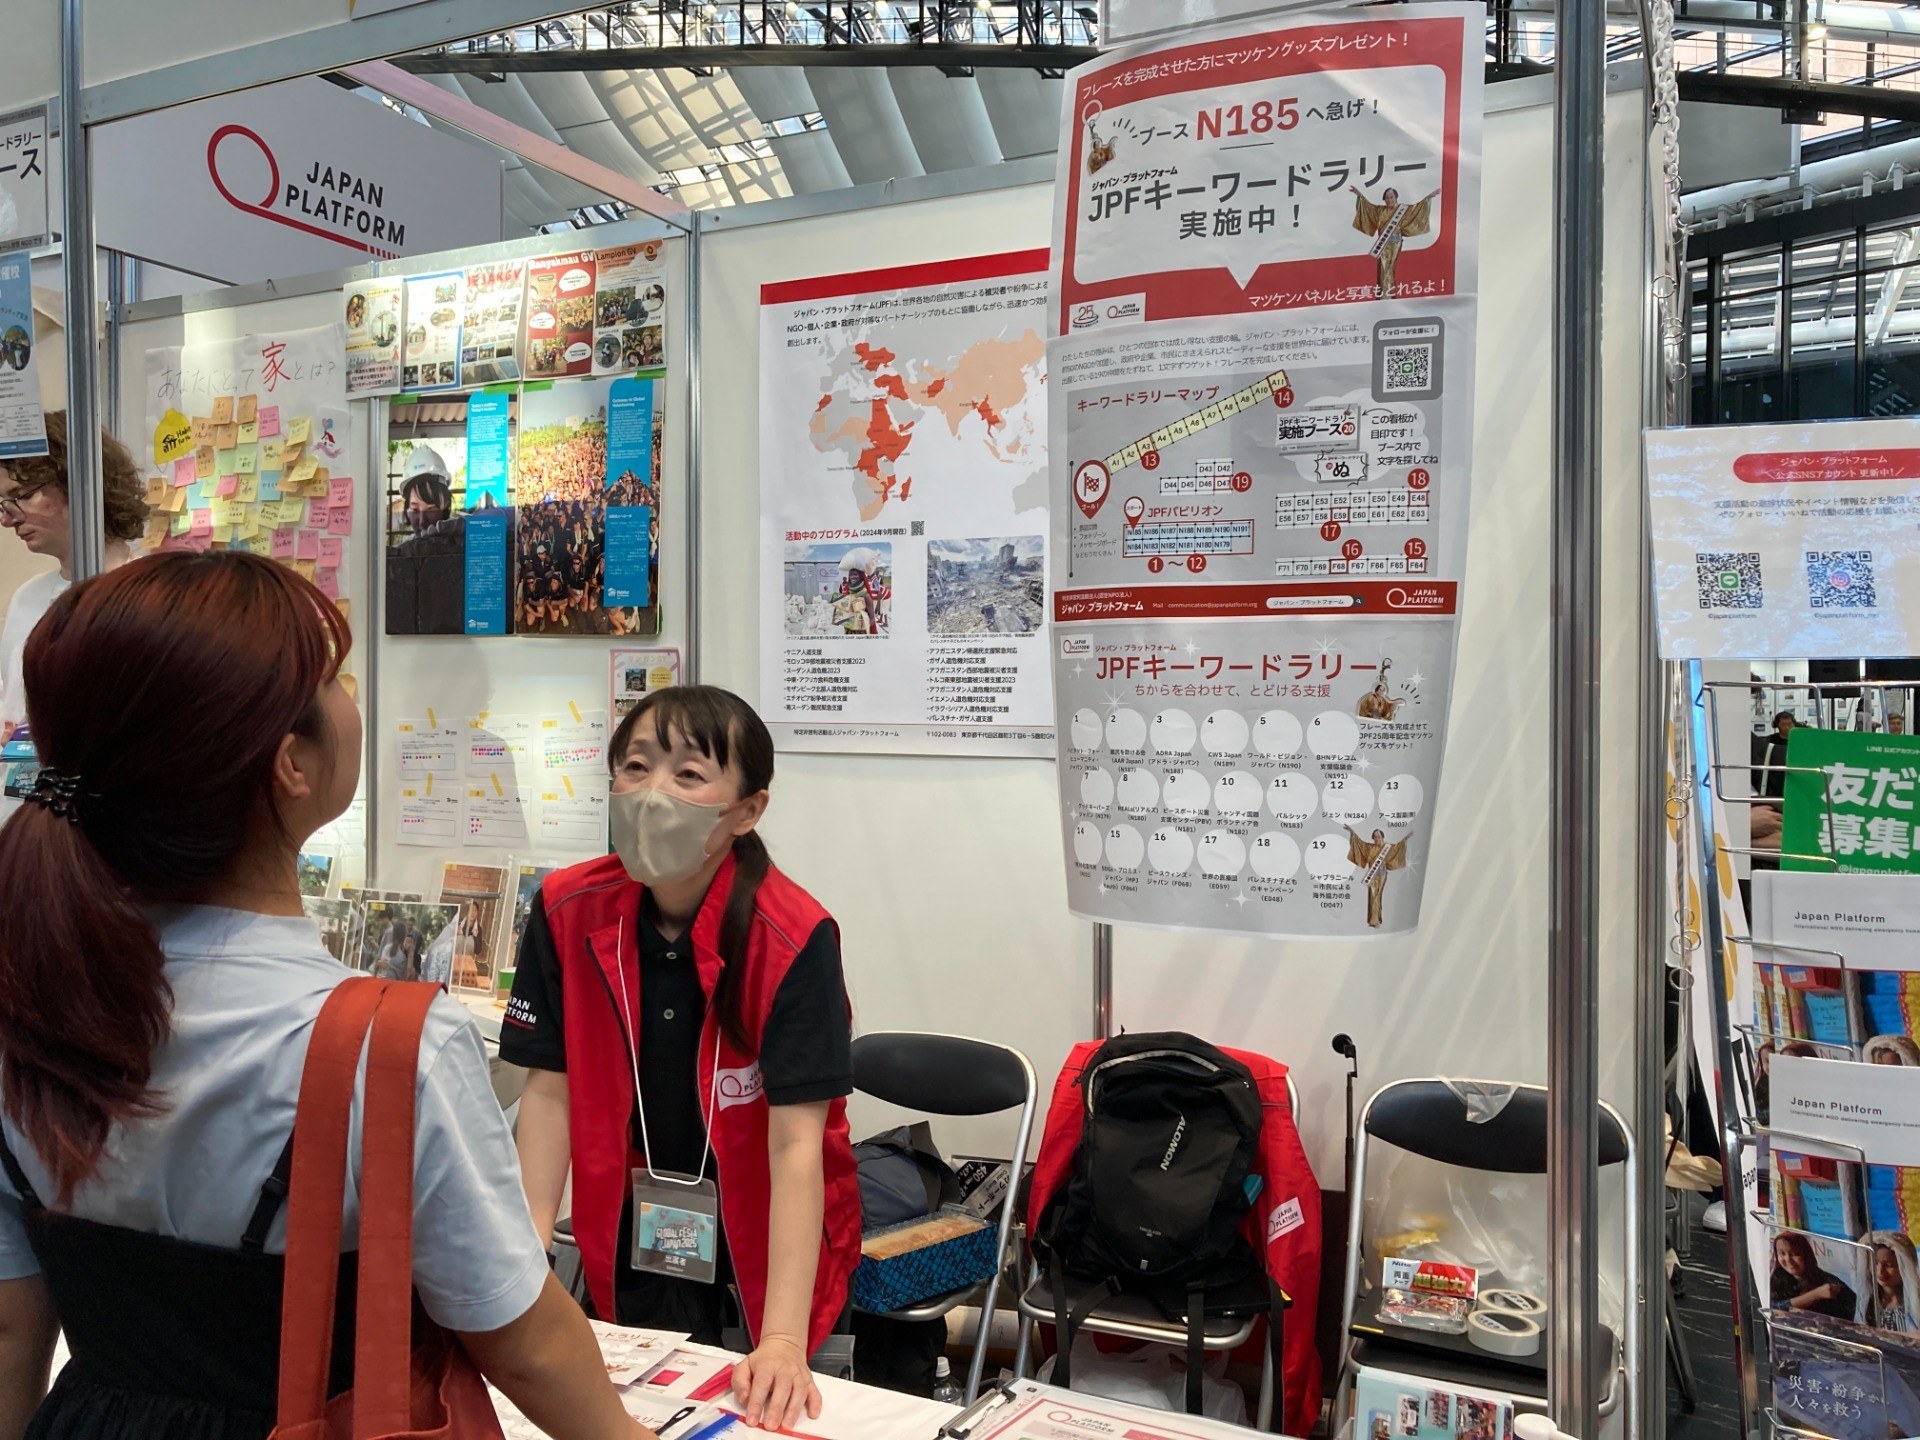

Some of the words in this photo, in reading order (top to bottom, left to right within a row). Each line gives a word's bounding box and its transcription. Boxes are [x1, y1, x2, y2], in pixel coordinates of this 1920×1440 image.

[1139, 121, 1189, 146] ブース
[1197, 97, 1300, 141] N185
[1306, 98, 1380, 121] へ急げ！
[1092, 165, 1178, 190] ジャパン・プラットフォーム
[306, 162, 384, 208] JAPAN
[1088, 154, 1428, 222] JPFキーワードラリー
[285, 184, 405, 246] PLATFORM
[1179, 203, 1301, 240] 実施中！
[581, 252, 594, 262] GV
[596, 249, 625, 260] Lampion
[627, 247, 637, 256] GV
[1248, 279, 1446, 308] マツケンパネルと写真もとれるよ！
[1077, 386, 1220, 412] キーワードラリーマップ
[1277, 391, 1291, 404] 14
[1280, 415, 1355, 426] JPFキーワードラリー
[1371, 412, 1417, 424] この看板が
[1279, 424, 1342, 440] 実施ブース
[1370, 429, 1414, 439] 目印です！
[1378, 442, 1421, 451] ブース内で
[1144, 454, 1157, 466] 13
[1377, 455, 1438, 466] 文字を探してね
[1780, 455, 1888, 467] ジャパン・プラットフォーム
[1199, 465, 1212, 473] D43
[1217, 464, 1231, 472] D42
[1333, 461, 1350, 477] ぬ
[1217, 479, 1230, 487] D47
[1235, 475, 1249, 488] 19
[1412, 473, 1425, 485] 18
[1392, 494, 1405, 502] E49
[1412, 494, 1425, 502] E48
[1147, 506, 1223, 518] JPFパビリオン
[1352, 511, 1366, 519] E60
[785, 529, 859, 541] 活動中のプログラム
[1324, 525, 1337, 537] 17
[1345, 544, 1358, 555] 16
[1407, 542, 1422, 555] 15
[1153, 559, 1158, 570] 1
[1190, 557, 1203, 569] 12
[1278, 564, 1290, 572] F71
[1407, 596, 1444, 604] PLATFORM
[1061, 601, 1144, 613] ジャパン・プラットフォーム
[1095, 644, 1176, 652] ジャパン・プラットフォーム
[1096, 653, 1377, 681] JPFキーワードラリー
[1135, 684, 1331, 698] ちからを合わせて、とどける支援
[1074, 714, 1079, 722] 1
[1110, 715, 1116, 723] 2
[1156, 715, 1162, 723] 3
[1207, 716, 1213, 724] 4
[1260, 717, 1266, 725] 5
[1360, 723, 1428, 731] フレーズを完成させて
[1866, 745, 1882, 753] LINE
[1224, 752, 1242, 760] Japan
[1123, 774, 1128, 782] 8
[1222, 777, 1234, 785] 10
[1274, 780, 1288, 788] 11
[1330, 781, 1344, 789] 12
[1386, 782, 1399, 790] 13
[1821, 762, 1920, 810] 友だ
[1275, 812, 1308, 820] パルシック
[1077, 826, 1084, 834] 14
[1110, 830, 1120, 838] 15
[1154, 833, 1166, 841] 16
[1205, 836, 1217, 844] 17
[1257, 838, 1270, 847] 18
[1312, 841, 1326, 849] 19
[1247, 876, 1297, 885] パレスチナ子ども
[1250, 886, 1294, 894] のキャンペーン
[1794, 911, 1830, 922] Japan
[1835, 912, 1886, 923] Platform
[507, 996, 530, 1011] APAN
[1790, 1096, 1826, 1109] Japan
[1830, 1101, 1882, 1116] Platform
[1394, 1270, 1409, 1279] 両面
[1788, 1394, 1861, 1419] 人々を救う
[1069, 1418, 1115, 1434] PLATFORM
[1080, 1417, 1111, 1428] JAPAN
